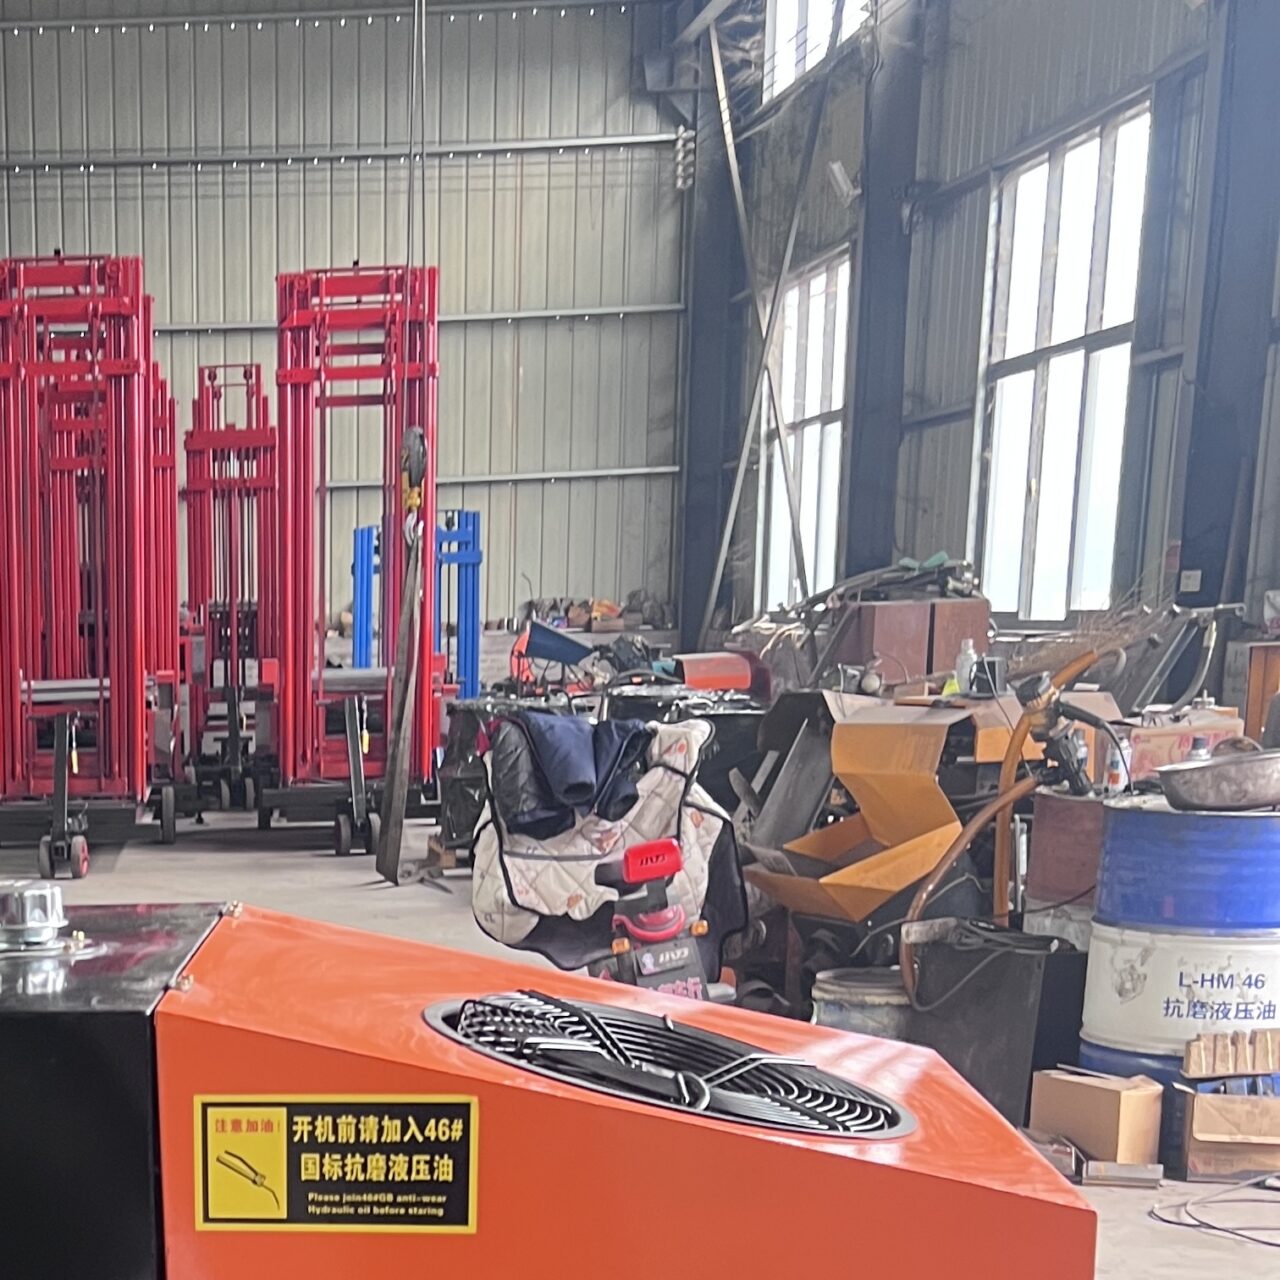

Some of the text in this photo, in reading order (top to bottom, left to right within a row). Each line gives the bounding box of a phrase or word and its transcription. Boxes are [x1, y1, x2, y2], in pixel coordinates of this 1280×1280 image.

[1179, 971, 1266, 990] L-HM 46
[1163, 996, 1276, 1020] 抗磨液压油
[292, 1114, 464, 1144] 开机前请加入46#
[300, 1152, 454, 1182] 国标抗磨液压油
[307, 1191, 340, 1203] Please
[396, 1192, 447, 1203] anti-wear
[307, 1204, 355, 1216] Hydraulic
[372, 1205, 406, 1215] before
